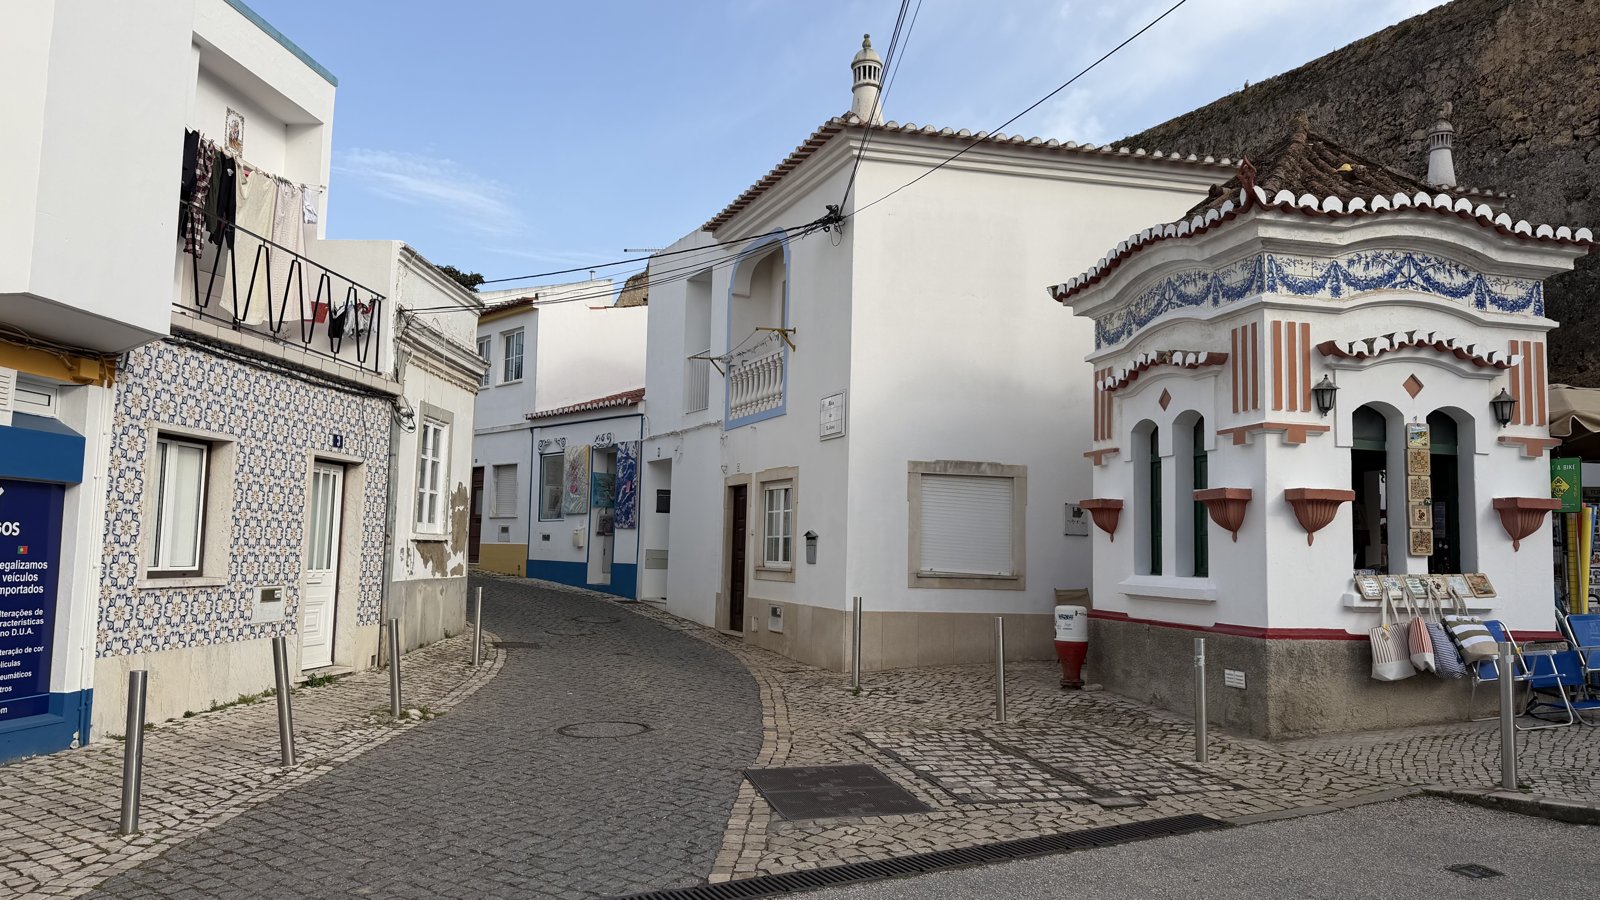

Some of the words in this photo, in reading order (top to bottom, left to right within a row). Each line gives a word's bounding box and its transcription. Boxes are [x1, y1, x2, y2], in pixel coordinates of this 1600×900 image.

[0, 521, 20, 536] OS
[2, 571, 39, 583] veículos
[34, 608, 43, 616] de
[11, 627, 34, 636] D.U.A.
[33, 645, 44, 653] cor
